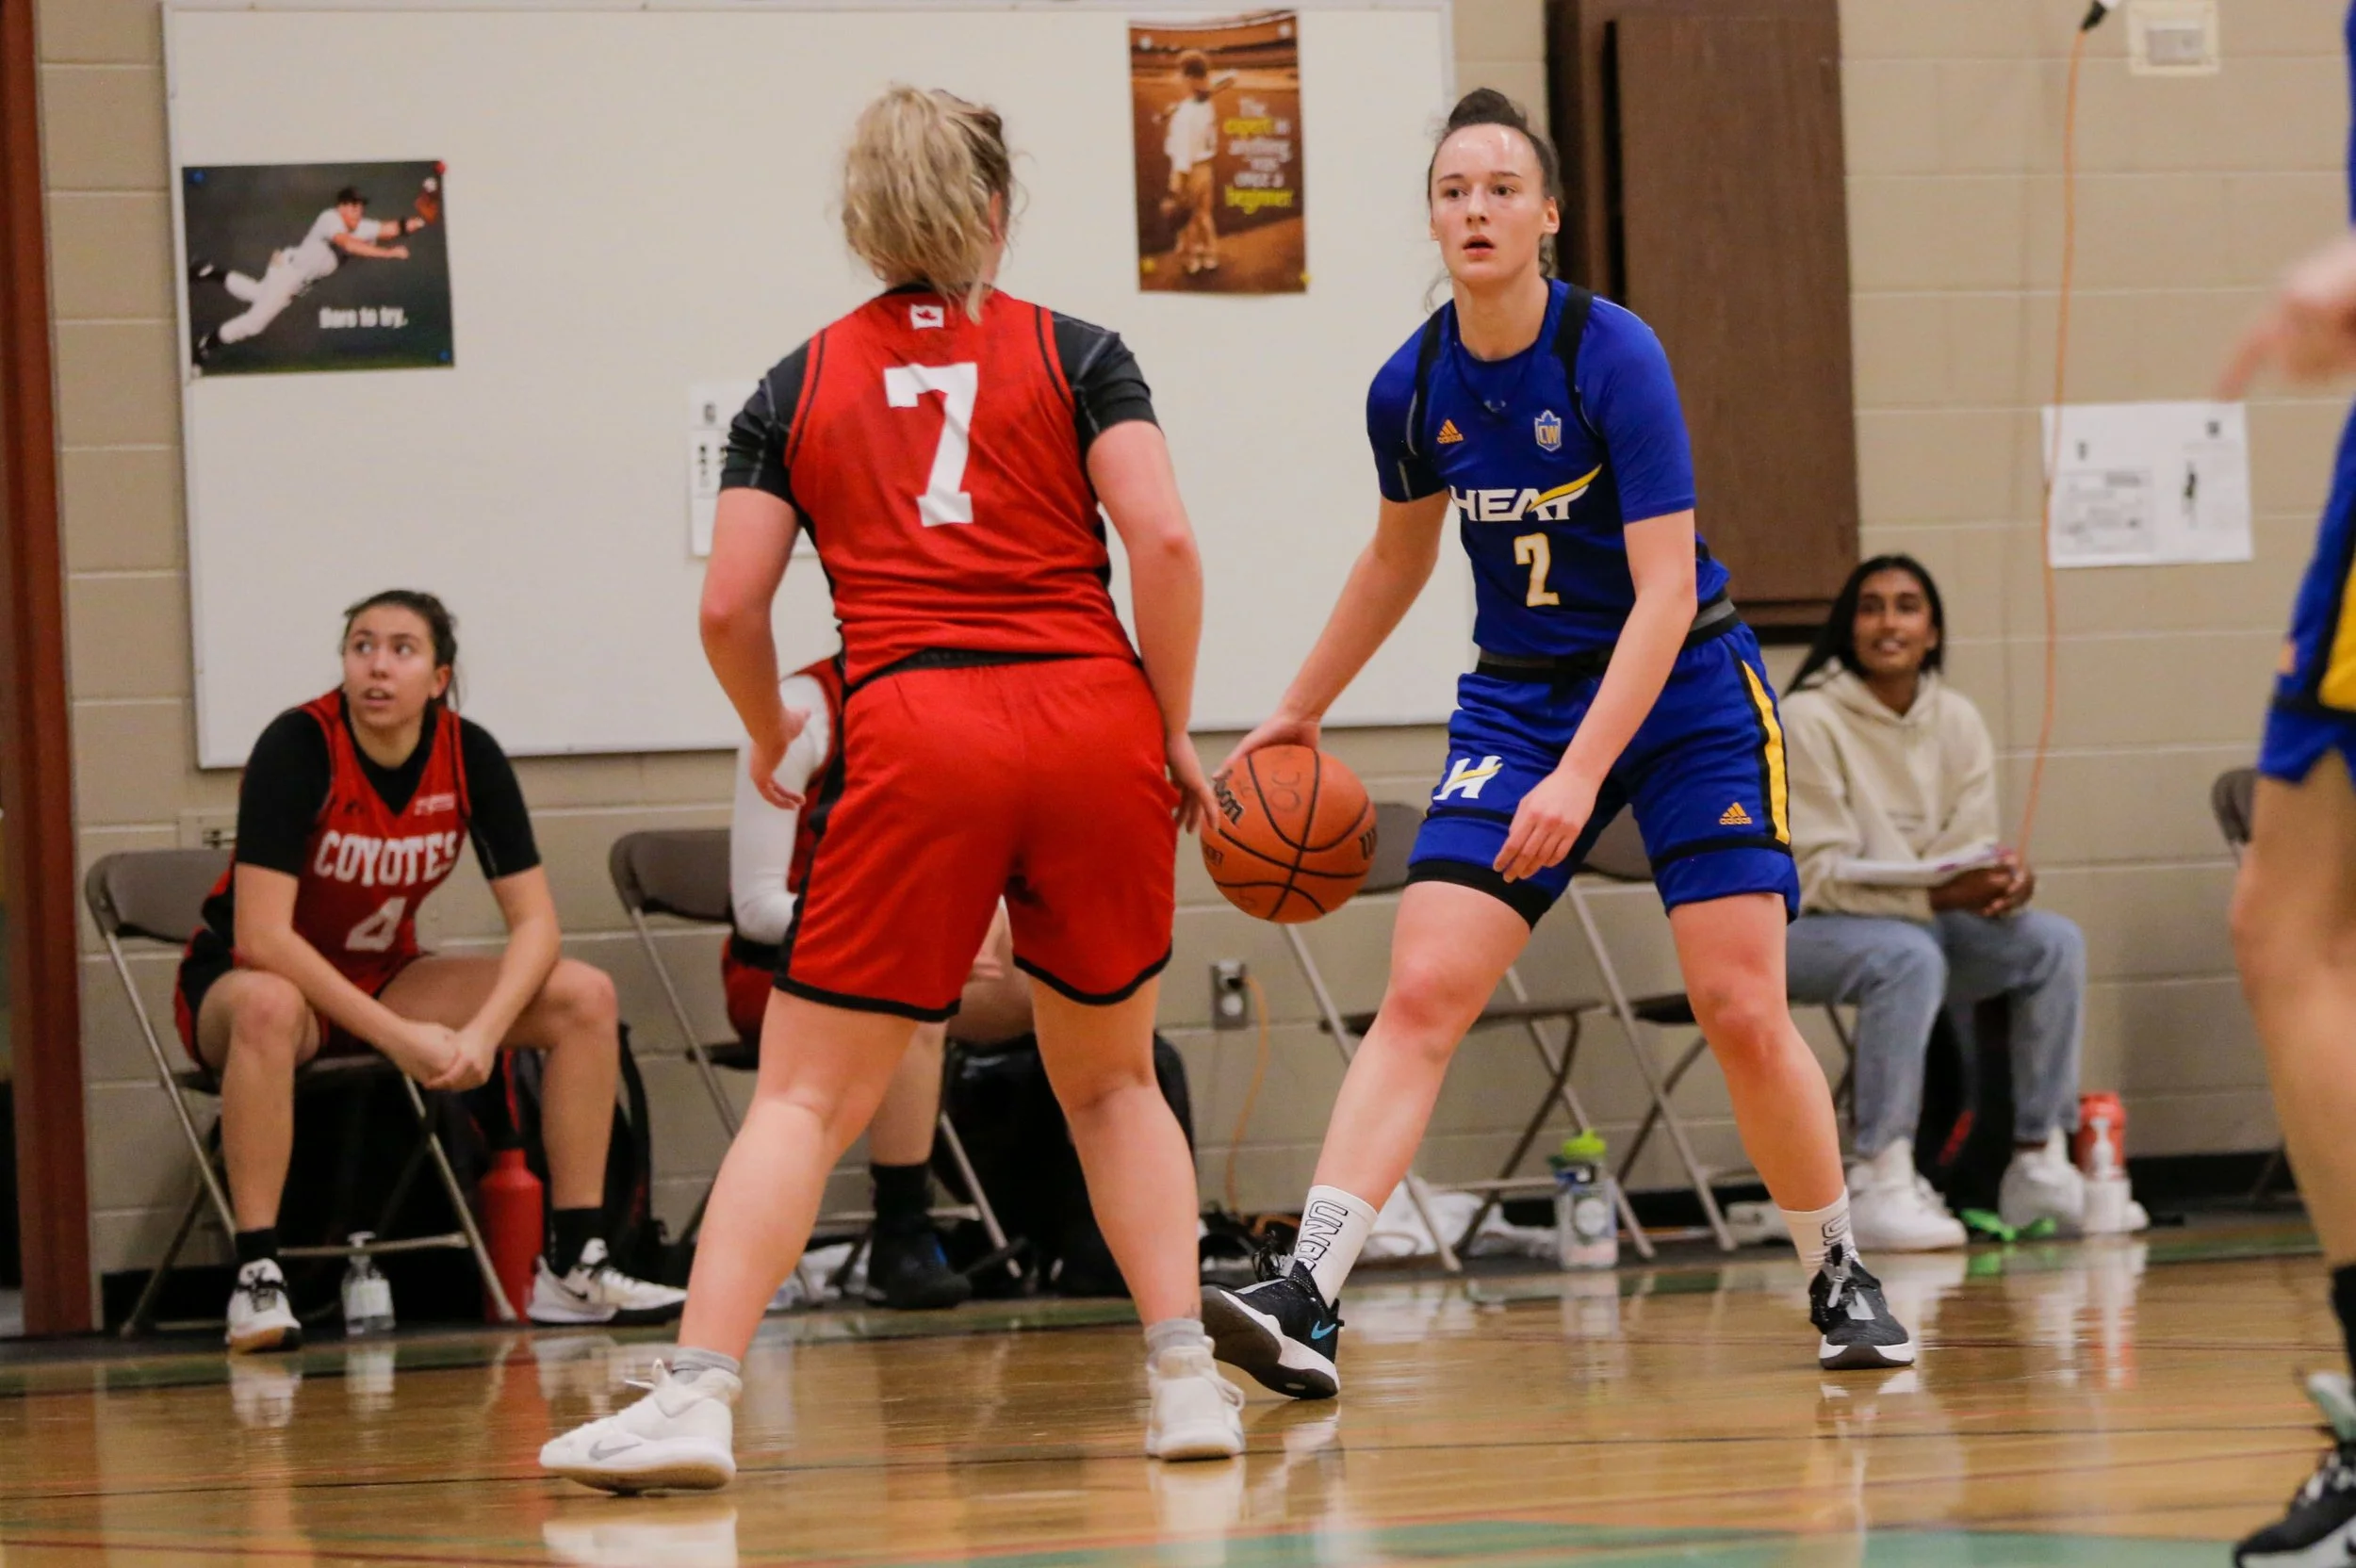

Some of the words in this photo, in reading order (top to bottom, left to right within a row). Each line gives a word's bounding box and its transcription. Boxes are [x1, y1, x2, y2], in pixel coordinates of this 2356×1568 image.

[884, 362, 979, 528] 7
[1448, 471, 1595, 521] HEAT
[1513, 531, 1560, 607] 2
[1432, 756, 1503, 800] H
[345, 897, 408, 952] 4
